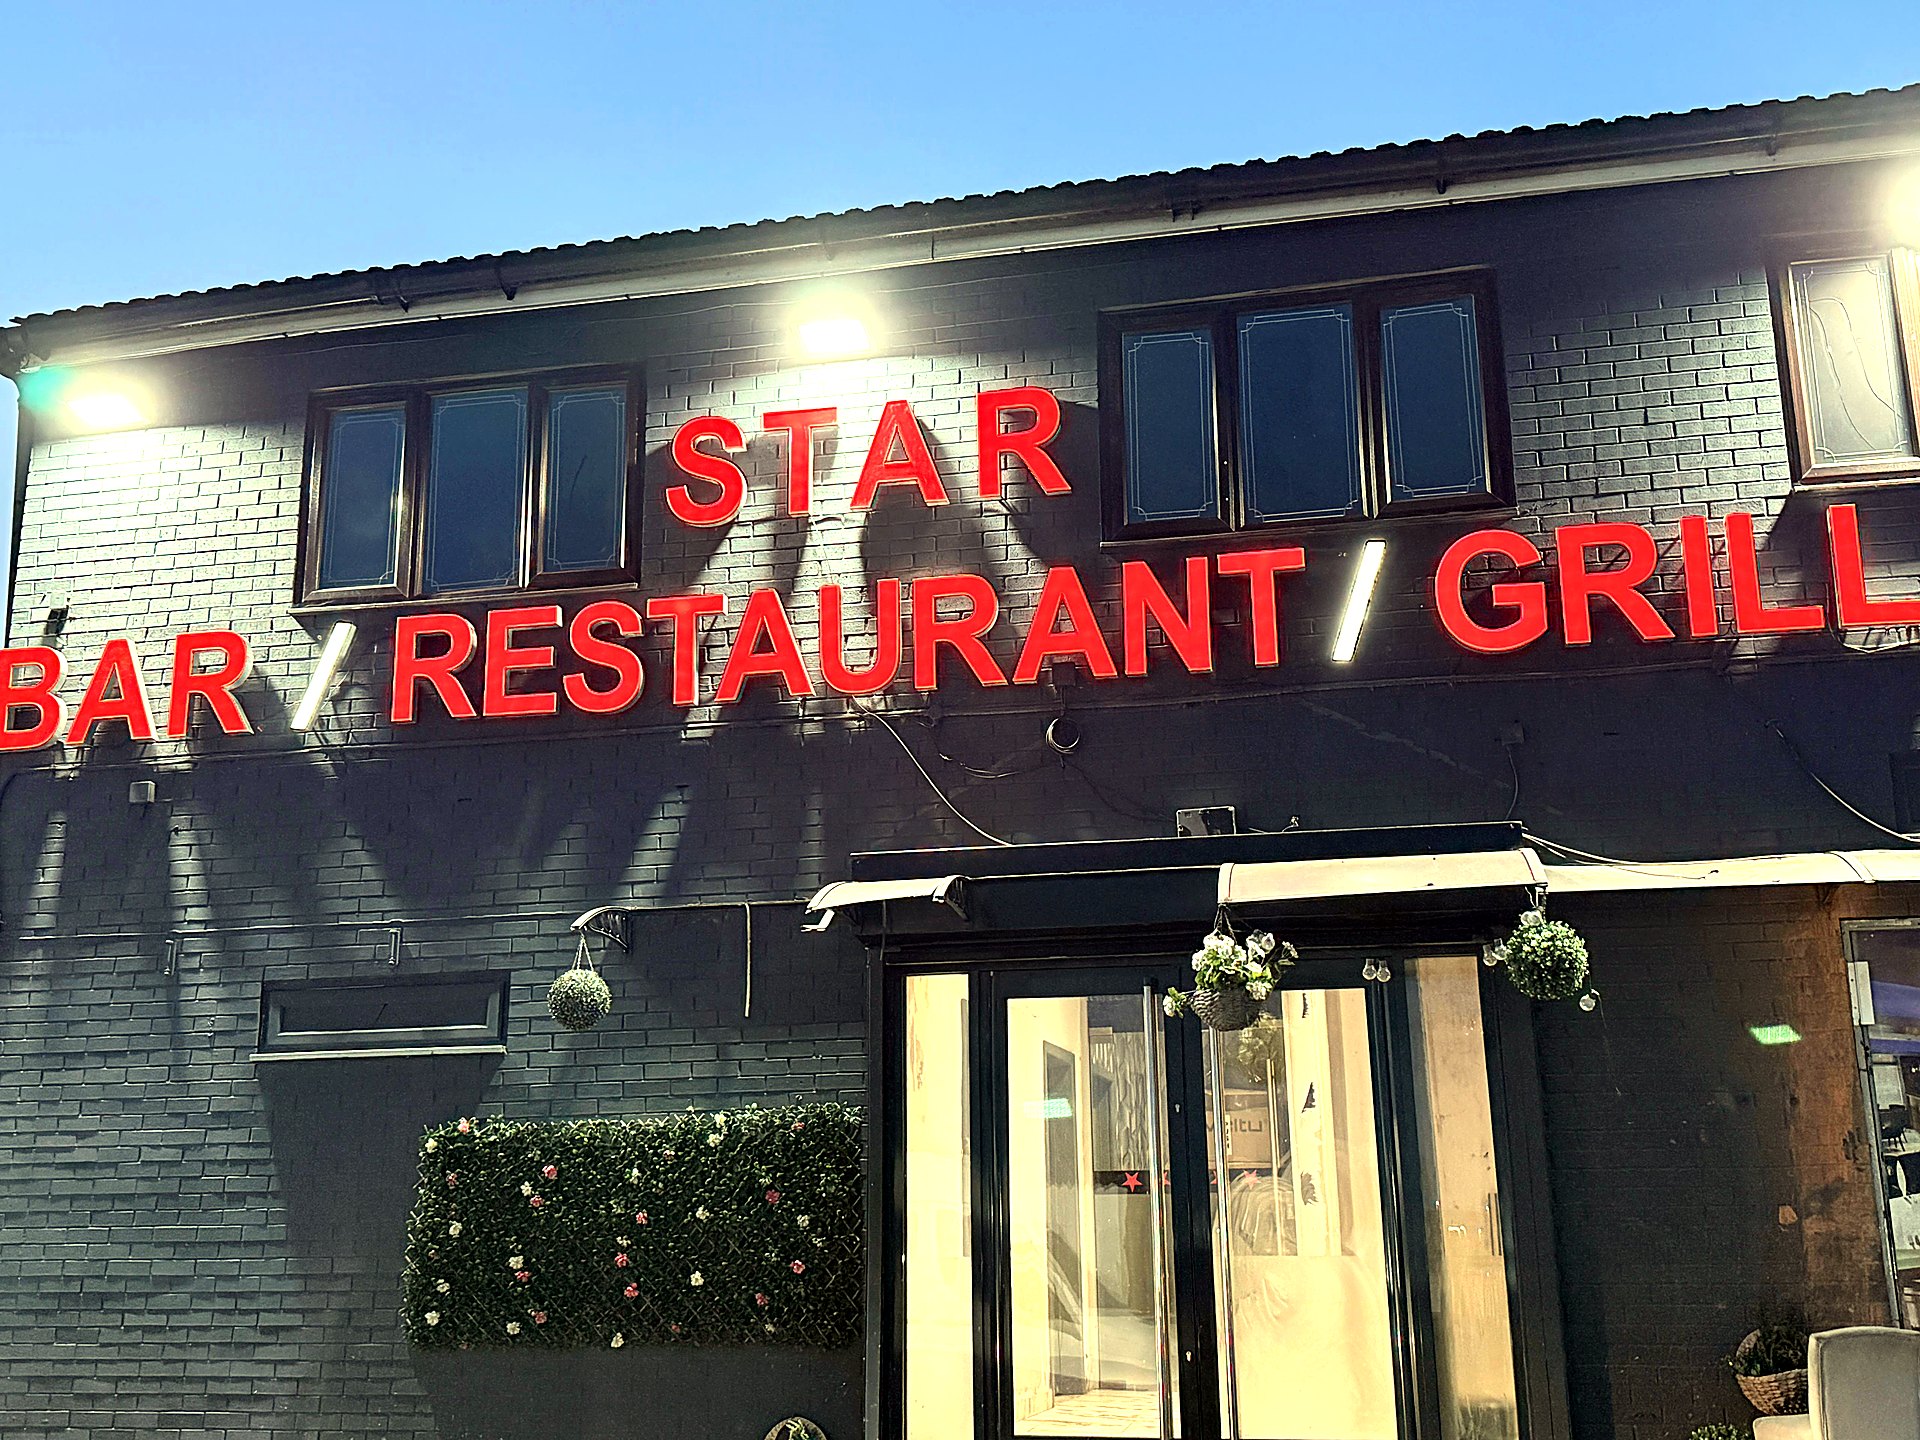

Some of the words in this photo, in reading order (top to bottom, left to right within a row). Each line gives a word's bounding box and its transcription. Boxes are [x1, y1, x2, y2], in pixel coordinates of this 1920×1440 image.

[667, 385, 1072, 527] STAR
[0, 629, 253, 751] BAR
[391, 546, 1305, 722] RESTAURANT
[1434, 503, 1920, 655] GRILL
